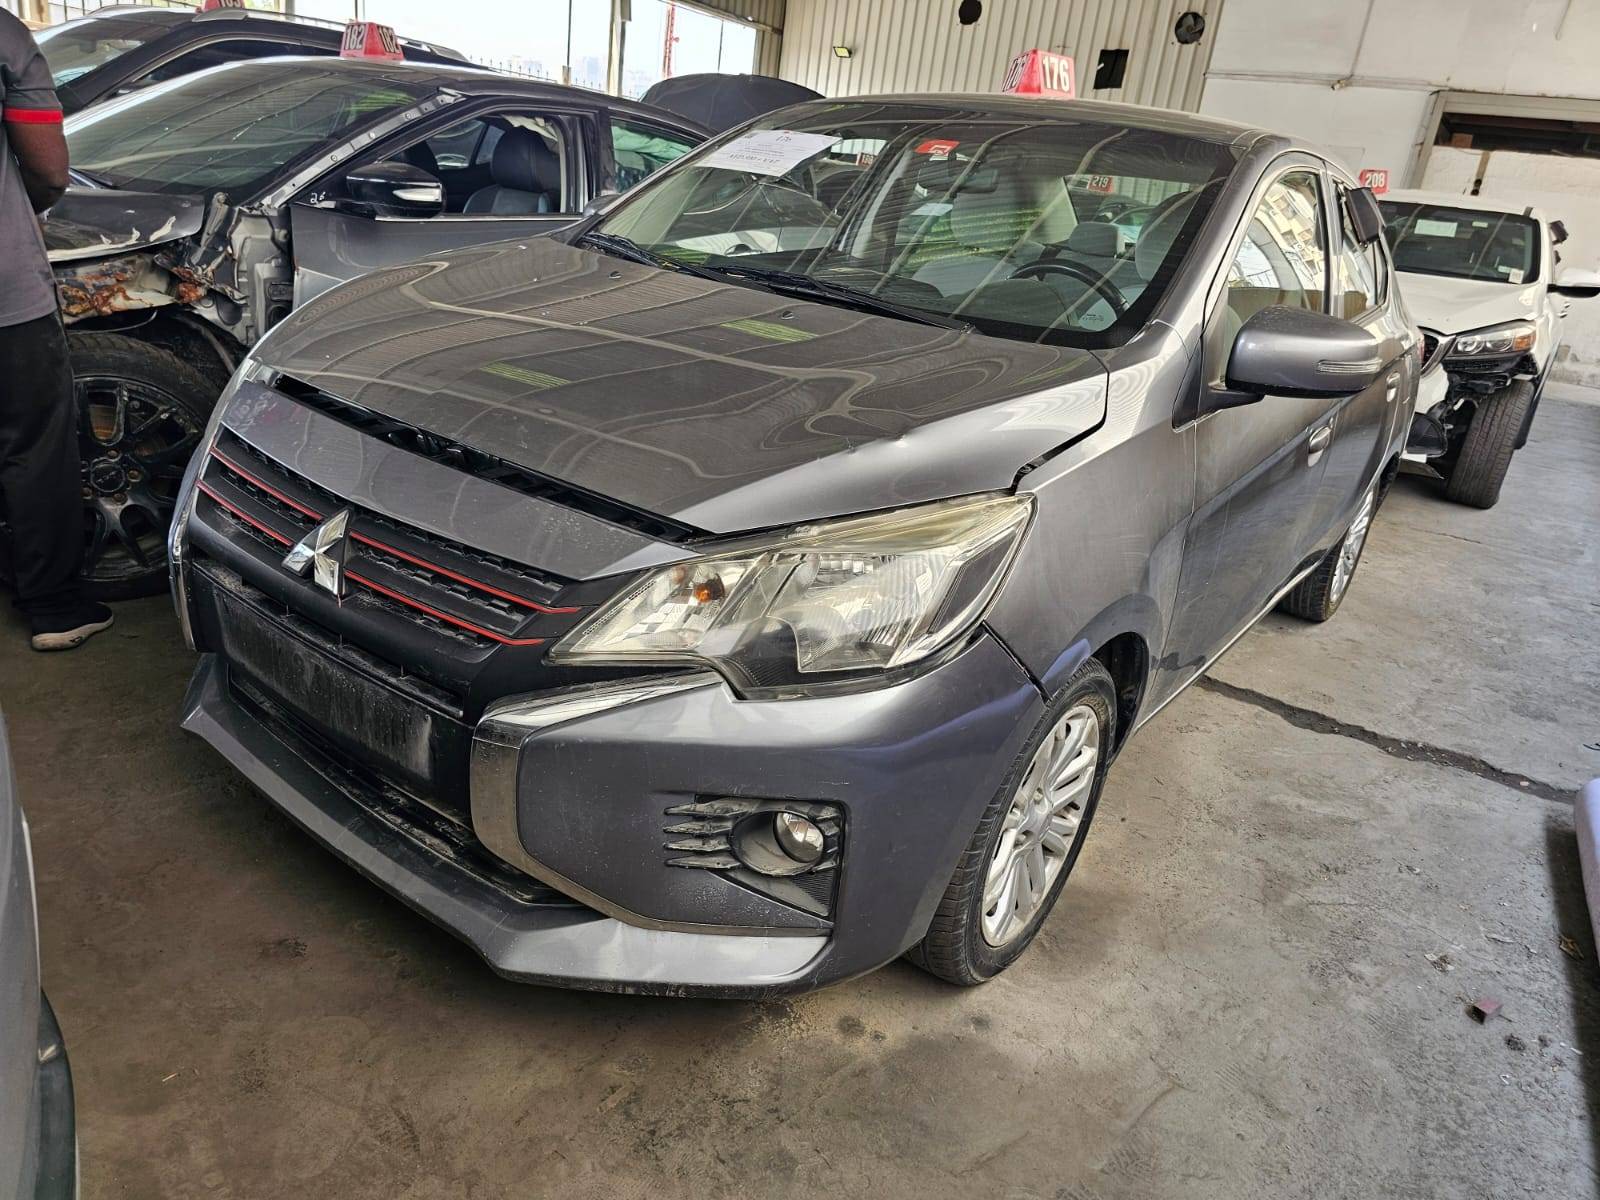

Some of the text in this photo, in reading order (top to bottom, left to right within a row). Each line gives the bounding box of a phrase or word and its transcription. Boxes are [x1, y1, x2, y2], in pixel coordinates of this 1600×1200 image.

[345, 24, 365, 50] 182
[1042, 55, 1070, 92] 176
[1092, 176, 1108, 188] 219
[1364, 172, 1385, 188] 208
